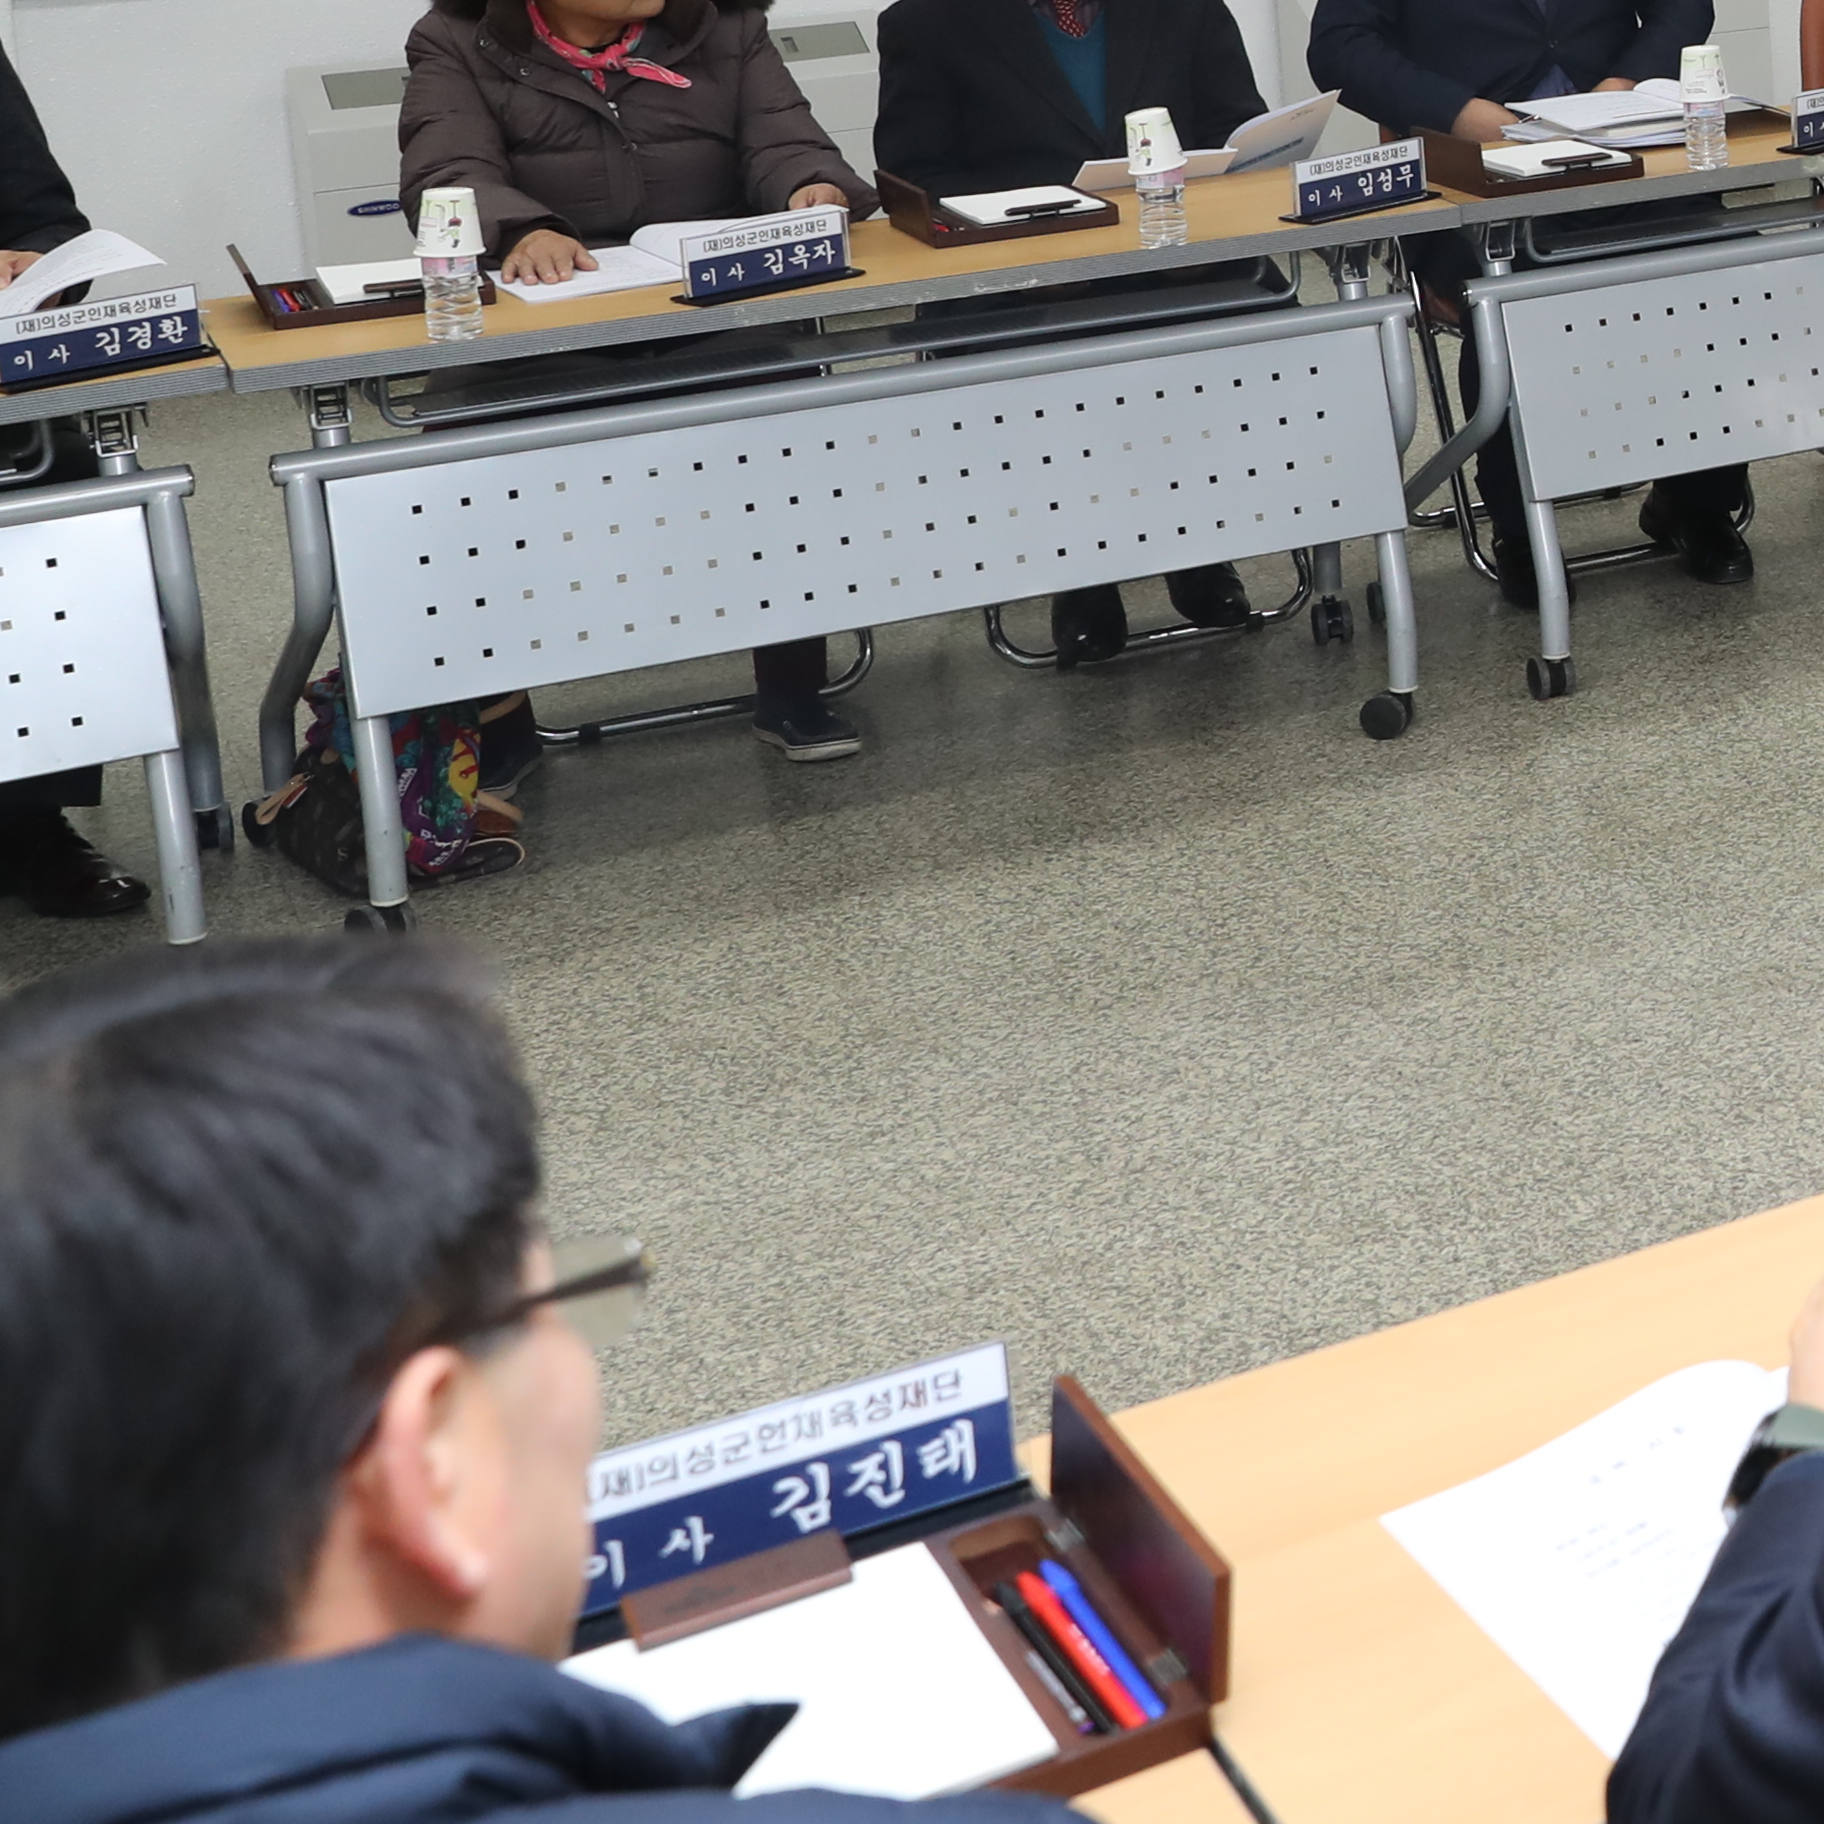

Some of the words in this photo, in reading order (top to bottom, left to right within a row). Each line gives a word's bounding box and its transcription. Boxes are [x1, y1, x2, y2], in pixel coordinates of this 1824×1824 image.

[1357, 163, 1415, 197] 임성무
[762, 239, 836, 276] 김옥자
[94, 315, 189, 357] 김경환
[769, 1417, 979, 1535] 김진태
